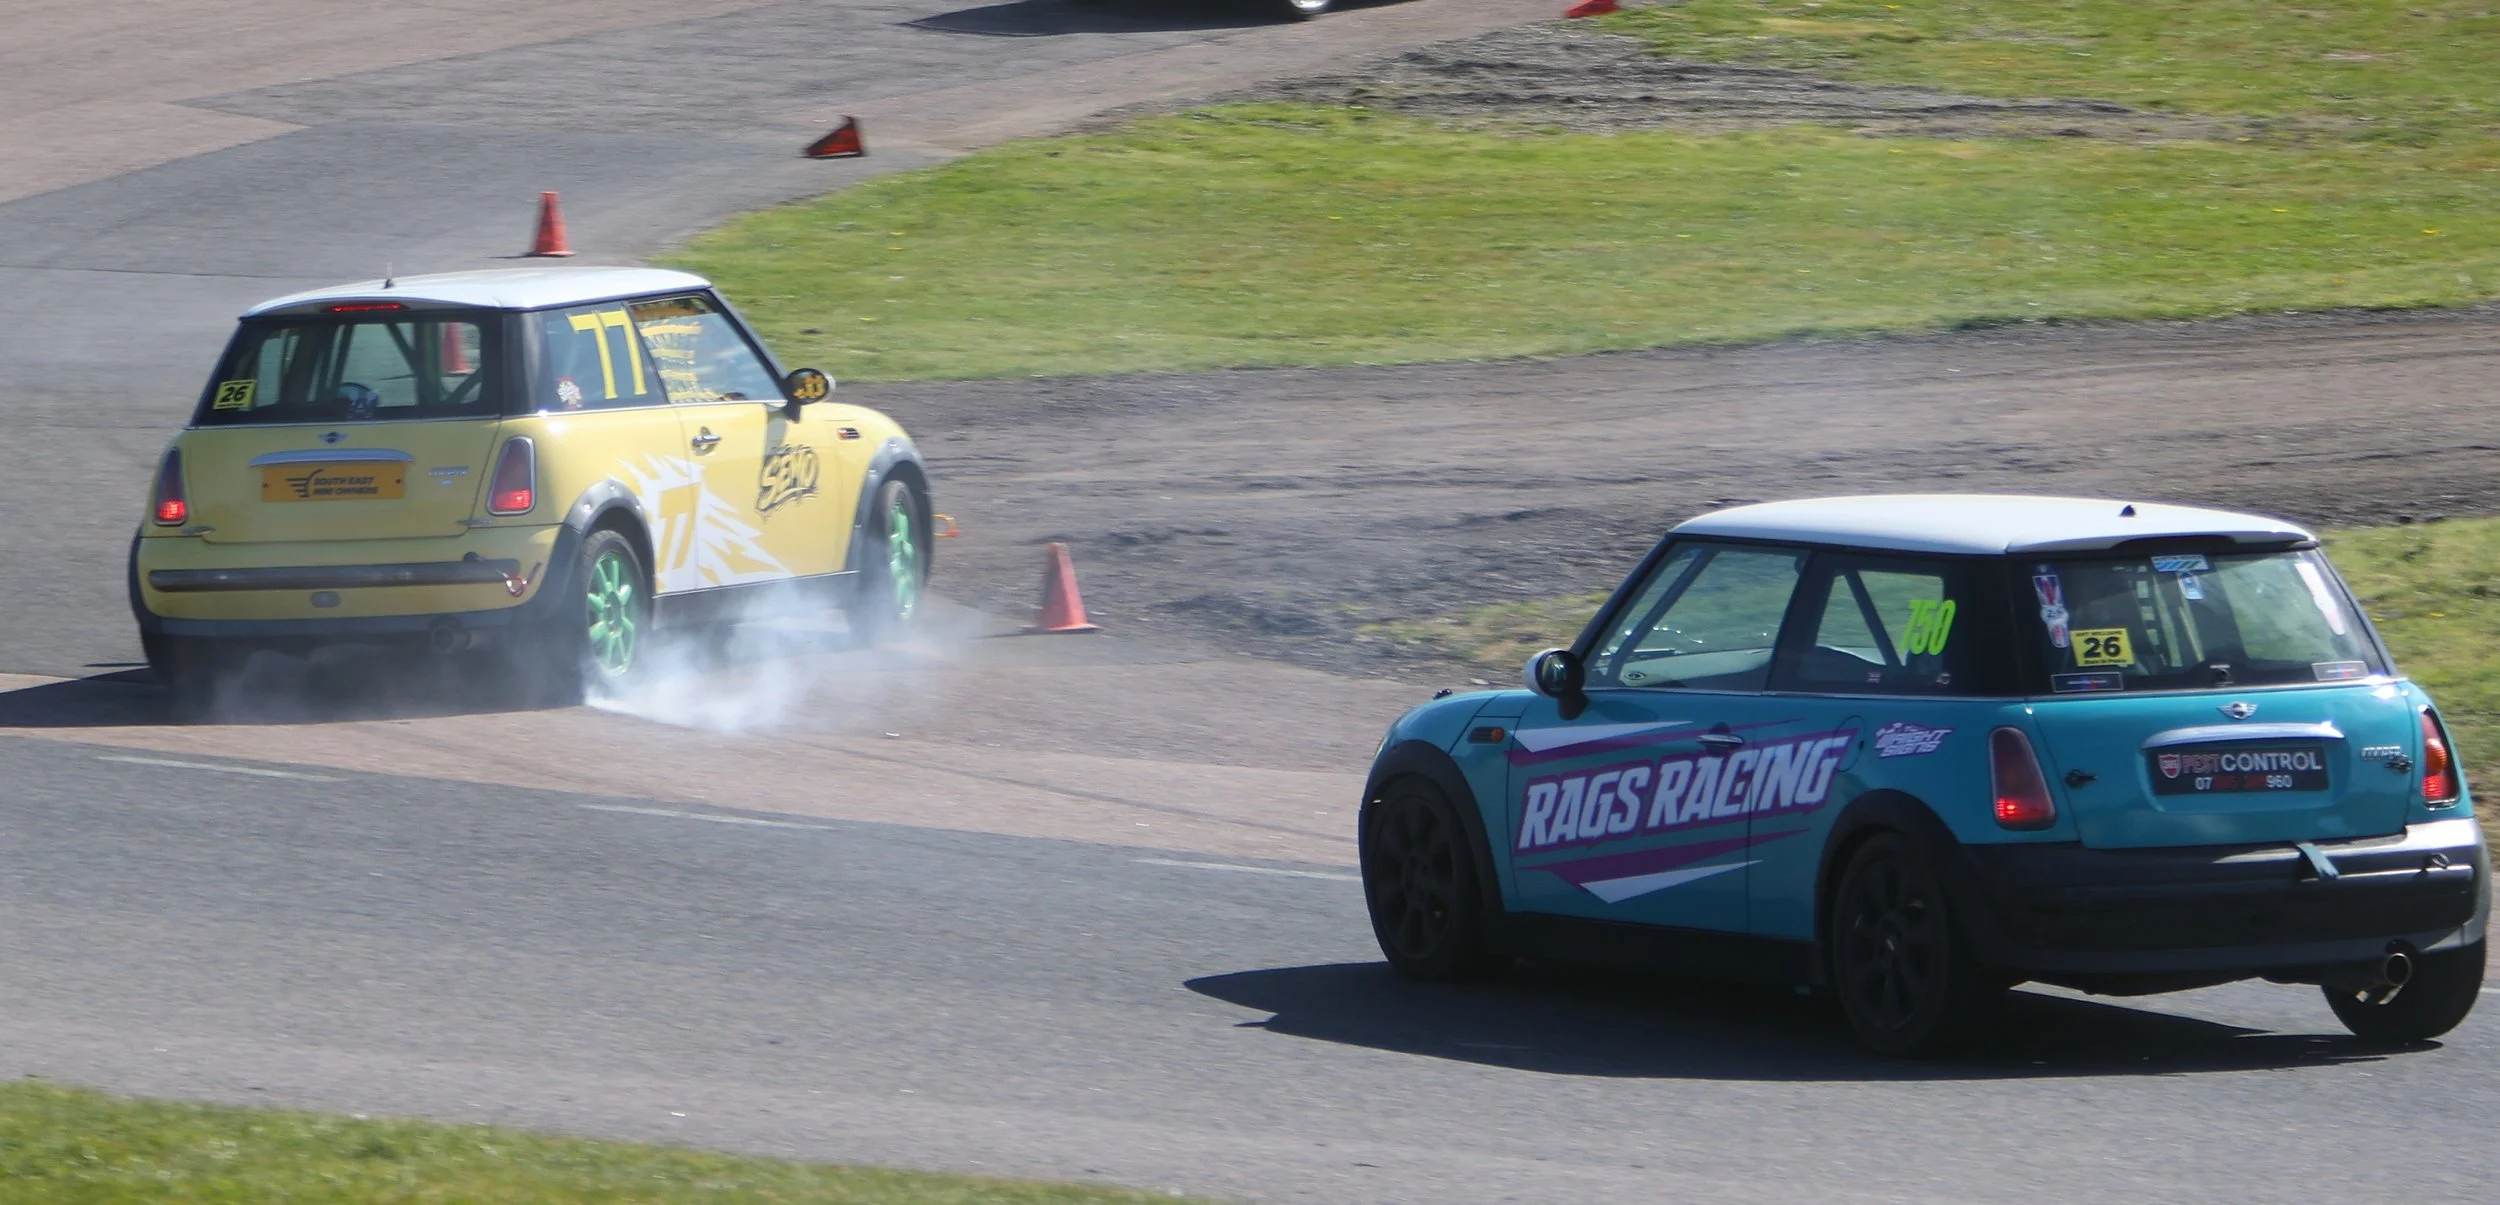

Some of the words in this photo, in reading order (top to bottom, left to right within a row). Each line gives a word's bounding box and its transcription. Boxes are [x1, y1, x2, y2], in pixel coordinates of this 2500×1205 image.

[566, 308, 647, 399] 77
[220, 385, 248, 402] 26
[2083, 636, 2121, 658] 26
[1518, 766, 1652, 849] RAGS
[1646, 735, 1851, 829] RACING
